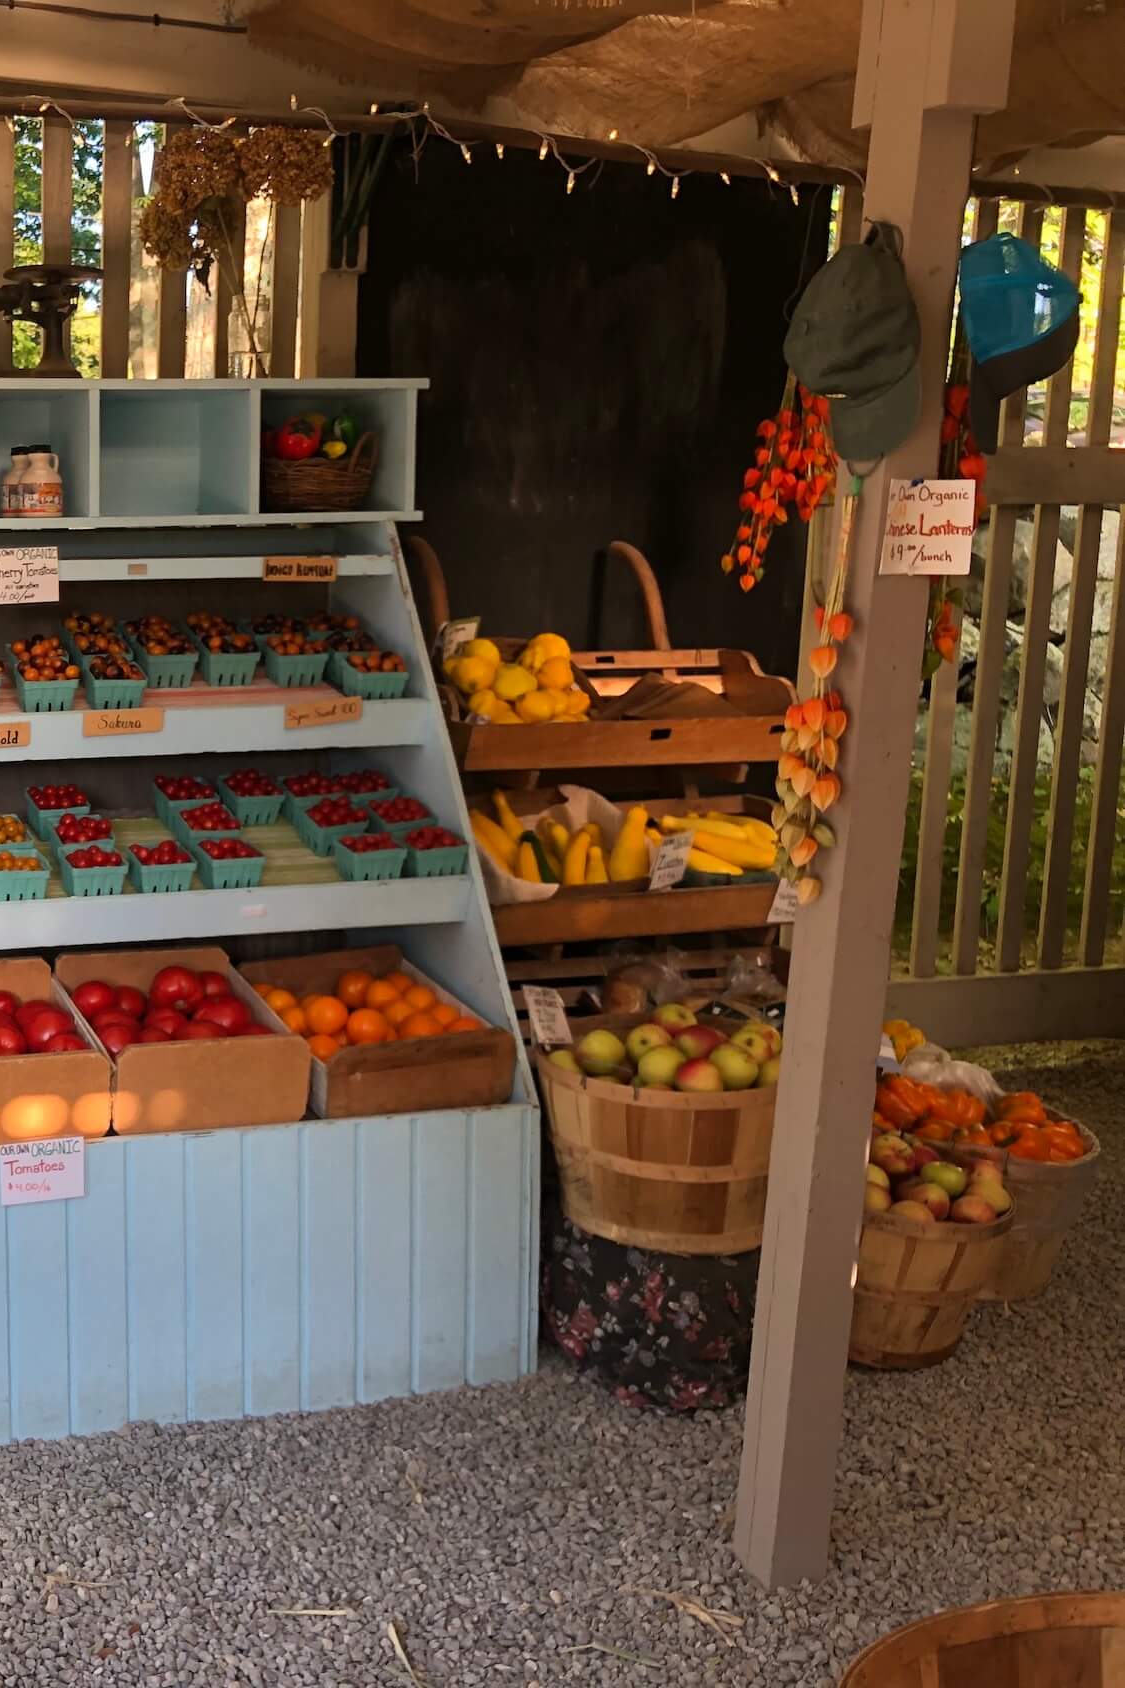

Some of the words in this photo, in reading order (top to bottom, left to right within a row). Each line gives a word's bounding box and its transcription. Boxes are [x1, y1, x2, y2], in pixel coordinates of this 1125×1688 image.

[919, 485, 970, 507] Organic
[16, 548, 58, 560] ORGANIC
[21, 562, 59, 577] Tomatoes
[97, 714, 142, 730] Sakura
[0, 1145, 15, 1156] OUR
[31, 1139, 80, 1157] ORGANIC
[3, 1159, 65, 1176] Tomatoes
